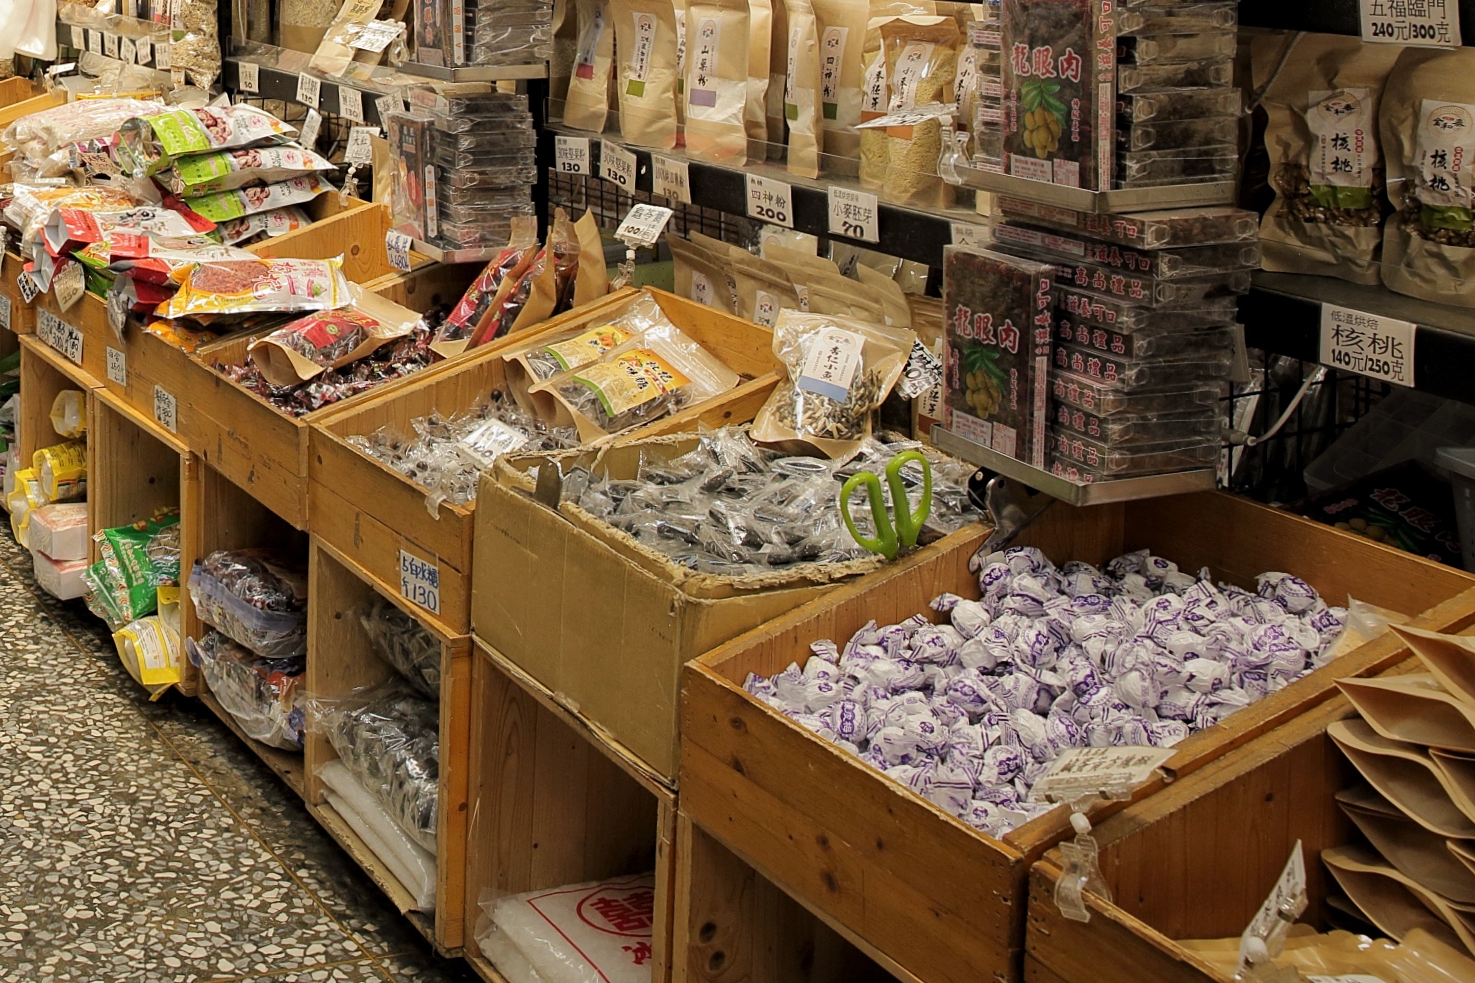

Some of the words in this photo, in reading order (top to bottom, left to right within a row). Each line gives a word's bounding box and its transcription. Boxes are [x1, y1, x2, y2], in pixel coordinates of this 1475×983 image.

[1370, 20, 1452, 45] 240元/300克
[1011, 42, 1082, 83] 龍眼肉
[1330, 132, 1353, 173] 核桃
[561, 162, 581, 173] 130
[606, 167, 627, 185] 130
[1428, 149, 1450, 192] 核桃
[662, 187, 680, 200] 130
[750, 189, 786, 209] 四神粉
[755, 205, 787, 222] 200
[832, 201, 873, 224] 小麥胚芽
[841, 220, 865, 238] 70
[1075, 266, 1144, 299] 高尚禮品
[954, 304, 1020, 354] 龍眼肉
[1330, 309, 1380, 331] 低溫烘焙
[1059, 320, 1126, 353] 高尚禮品
[1330, 324, 1405, 361] 核桃
[1056, 346, 1118, 382] 高尚禮品
[1330, 348, 1406, 383] 140元/250克
[413, 583, 437, 612] 130
